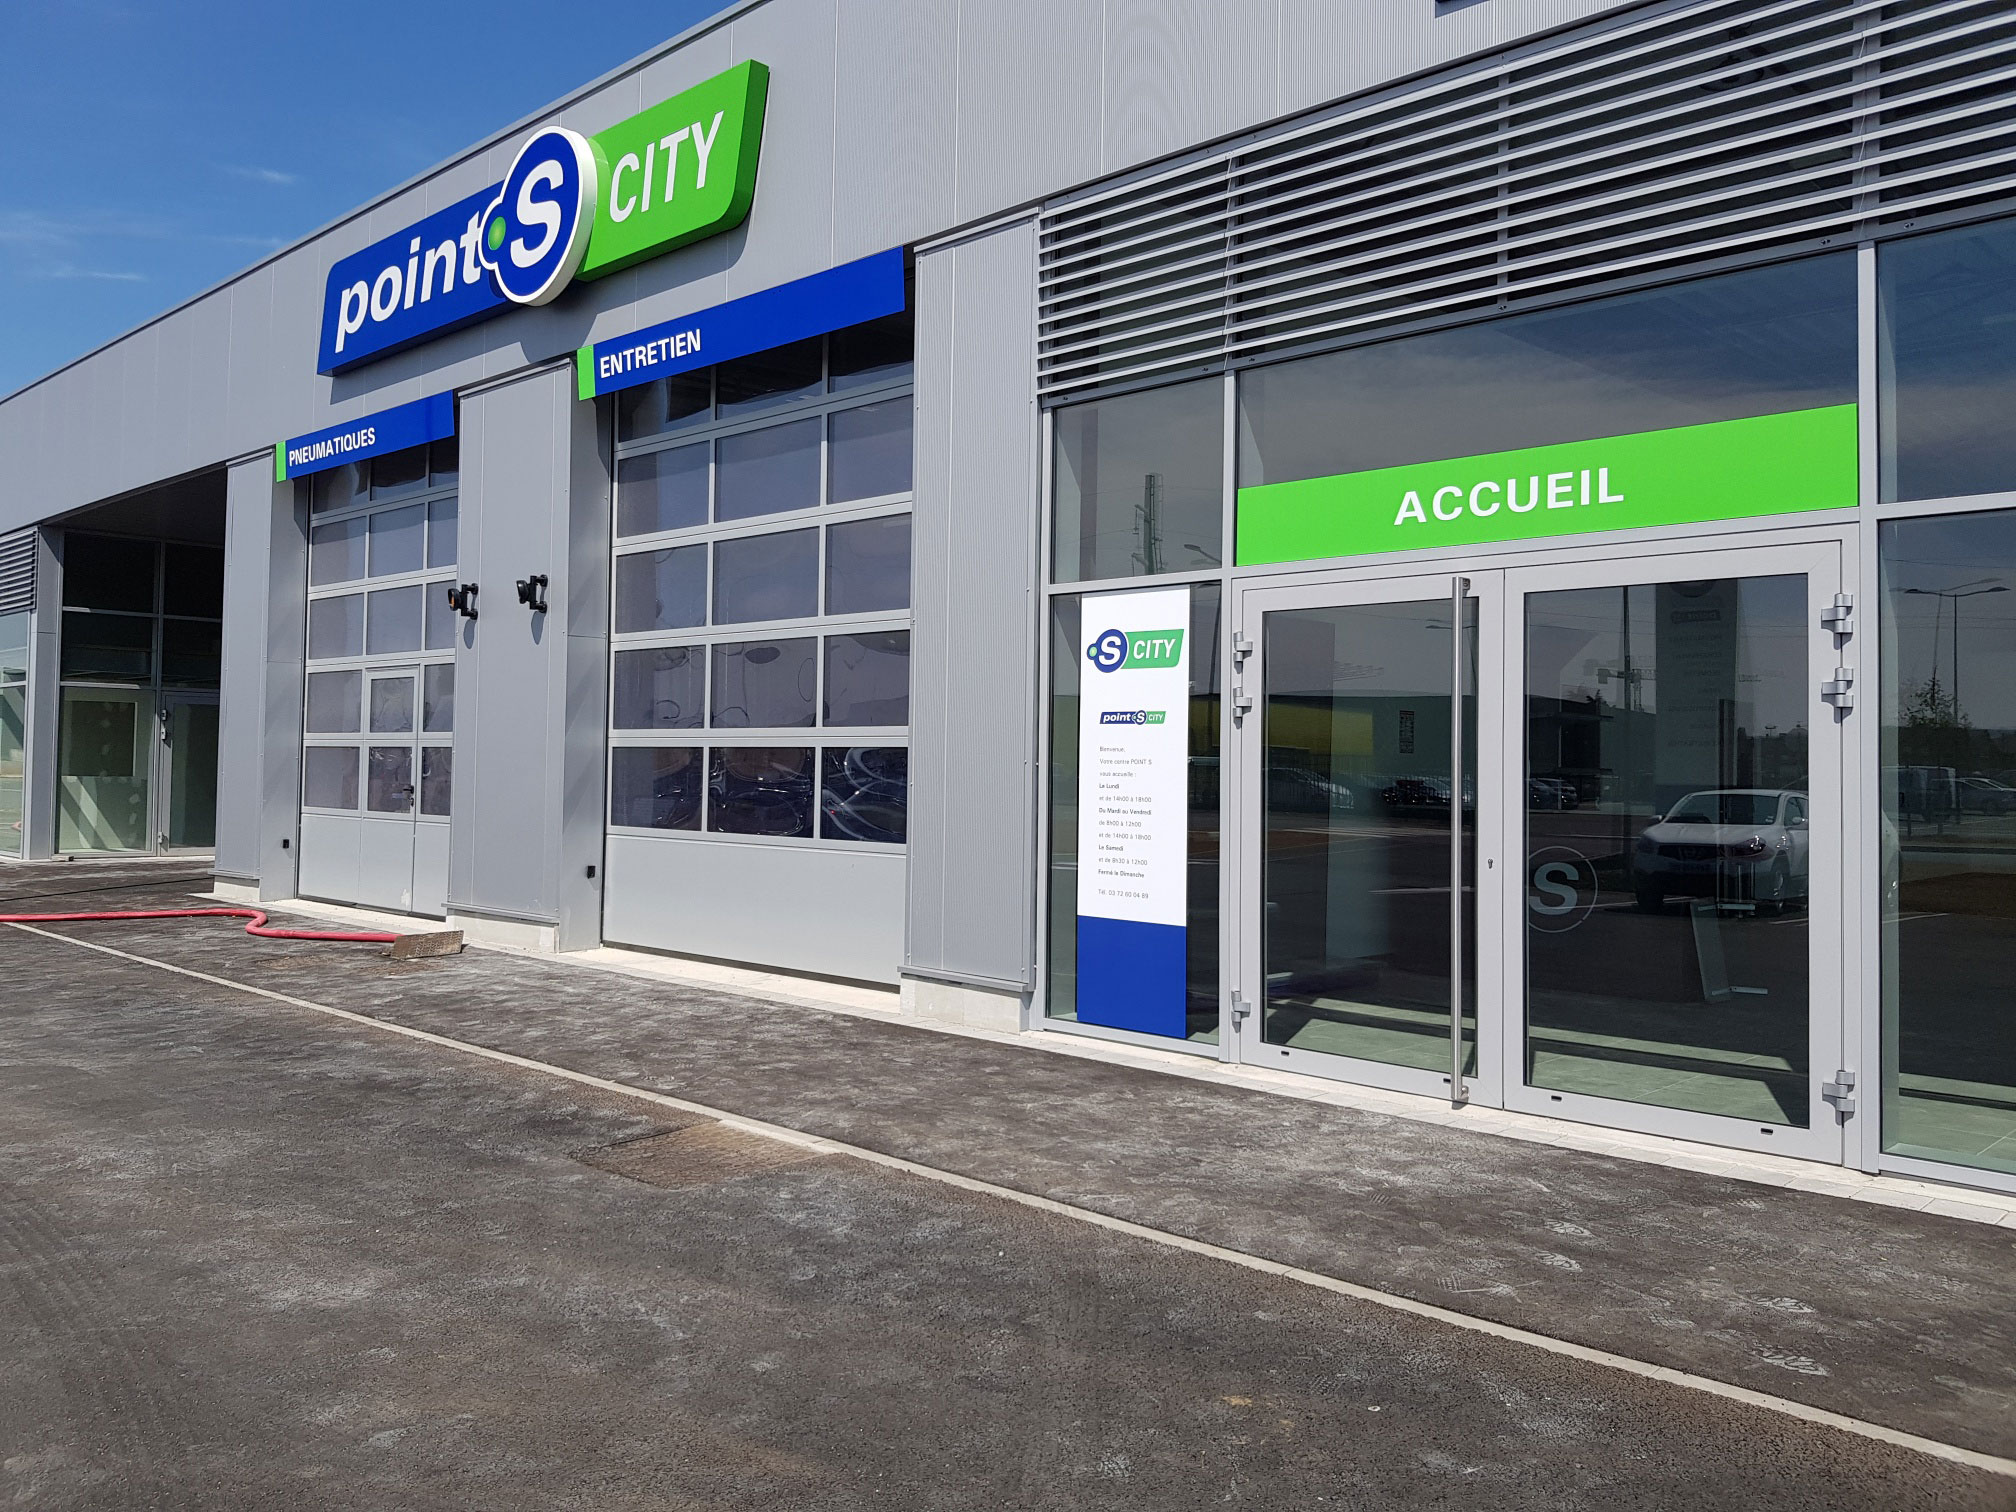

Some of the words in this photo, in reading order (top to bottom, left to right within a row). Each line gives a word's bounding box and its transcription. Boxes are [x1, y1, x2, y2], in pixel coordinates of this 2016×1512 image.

[335, 210, 483, 353] point
[510, 158, 563, 267] S
[609, 111, 724, 223] CITY
[600, 329, 701, 378] ENTRETIEN
[288, 427, 376, 466] PNEUMATIQUES
[1393, 467, 1625, 526] ACCUEIL
[1099, 636, 1121, 665] S
[1133, 639, 1176, 659] CITY
[1102, 713, 1131, 722] point
[1120, 870, 1145, 878] Dimanche
[1530, 862, 1579, 916] S
